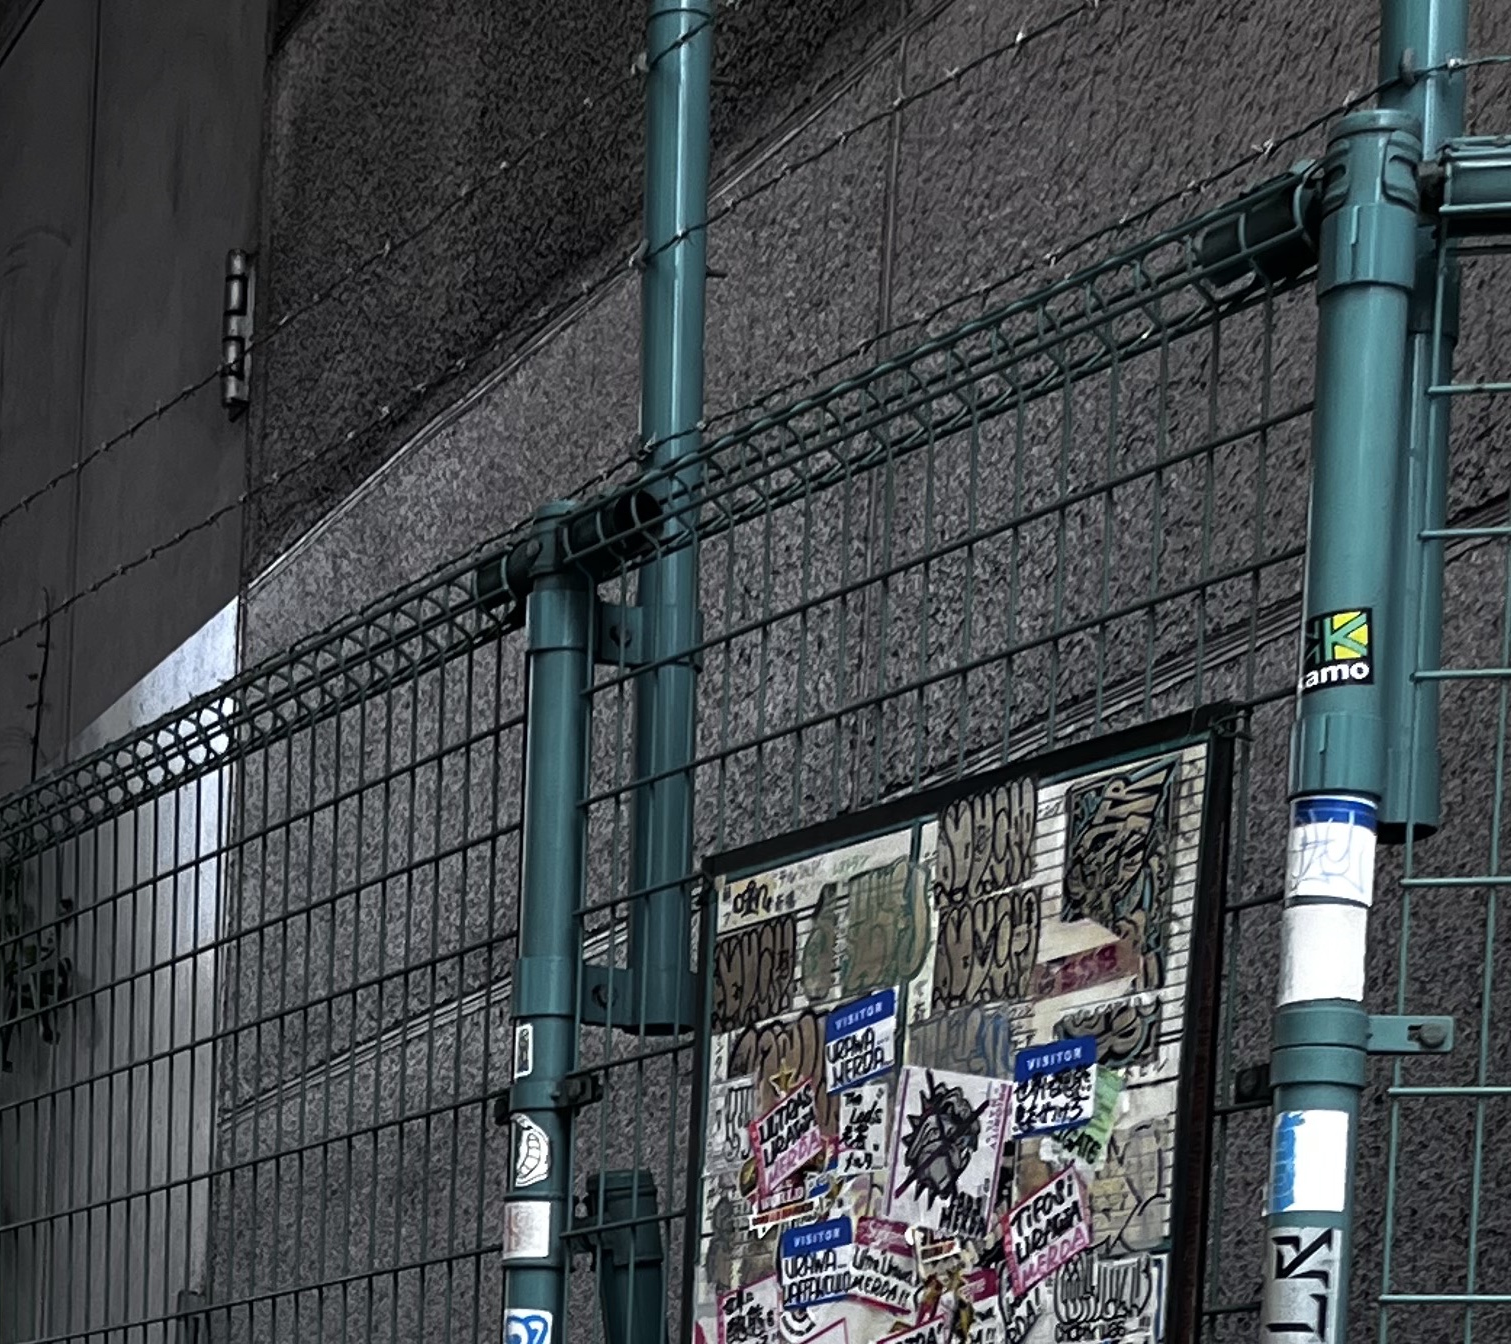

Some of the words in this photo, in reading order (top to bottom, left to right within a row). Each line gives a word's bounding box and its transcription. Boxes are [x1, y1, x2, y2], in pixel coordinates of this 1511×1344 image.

[1299, 662, 1369, 688] amo
[835, 1002, 883, 1030] VISITOR
[1026, 1046, 1082, 1071] VISITOR
[794, 1227, 840, 1247] VISITOR
[1022, 1227, 1085, 1285] MERDA
